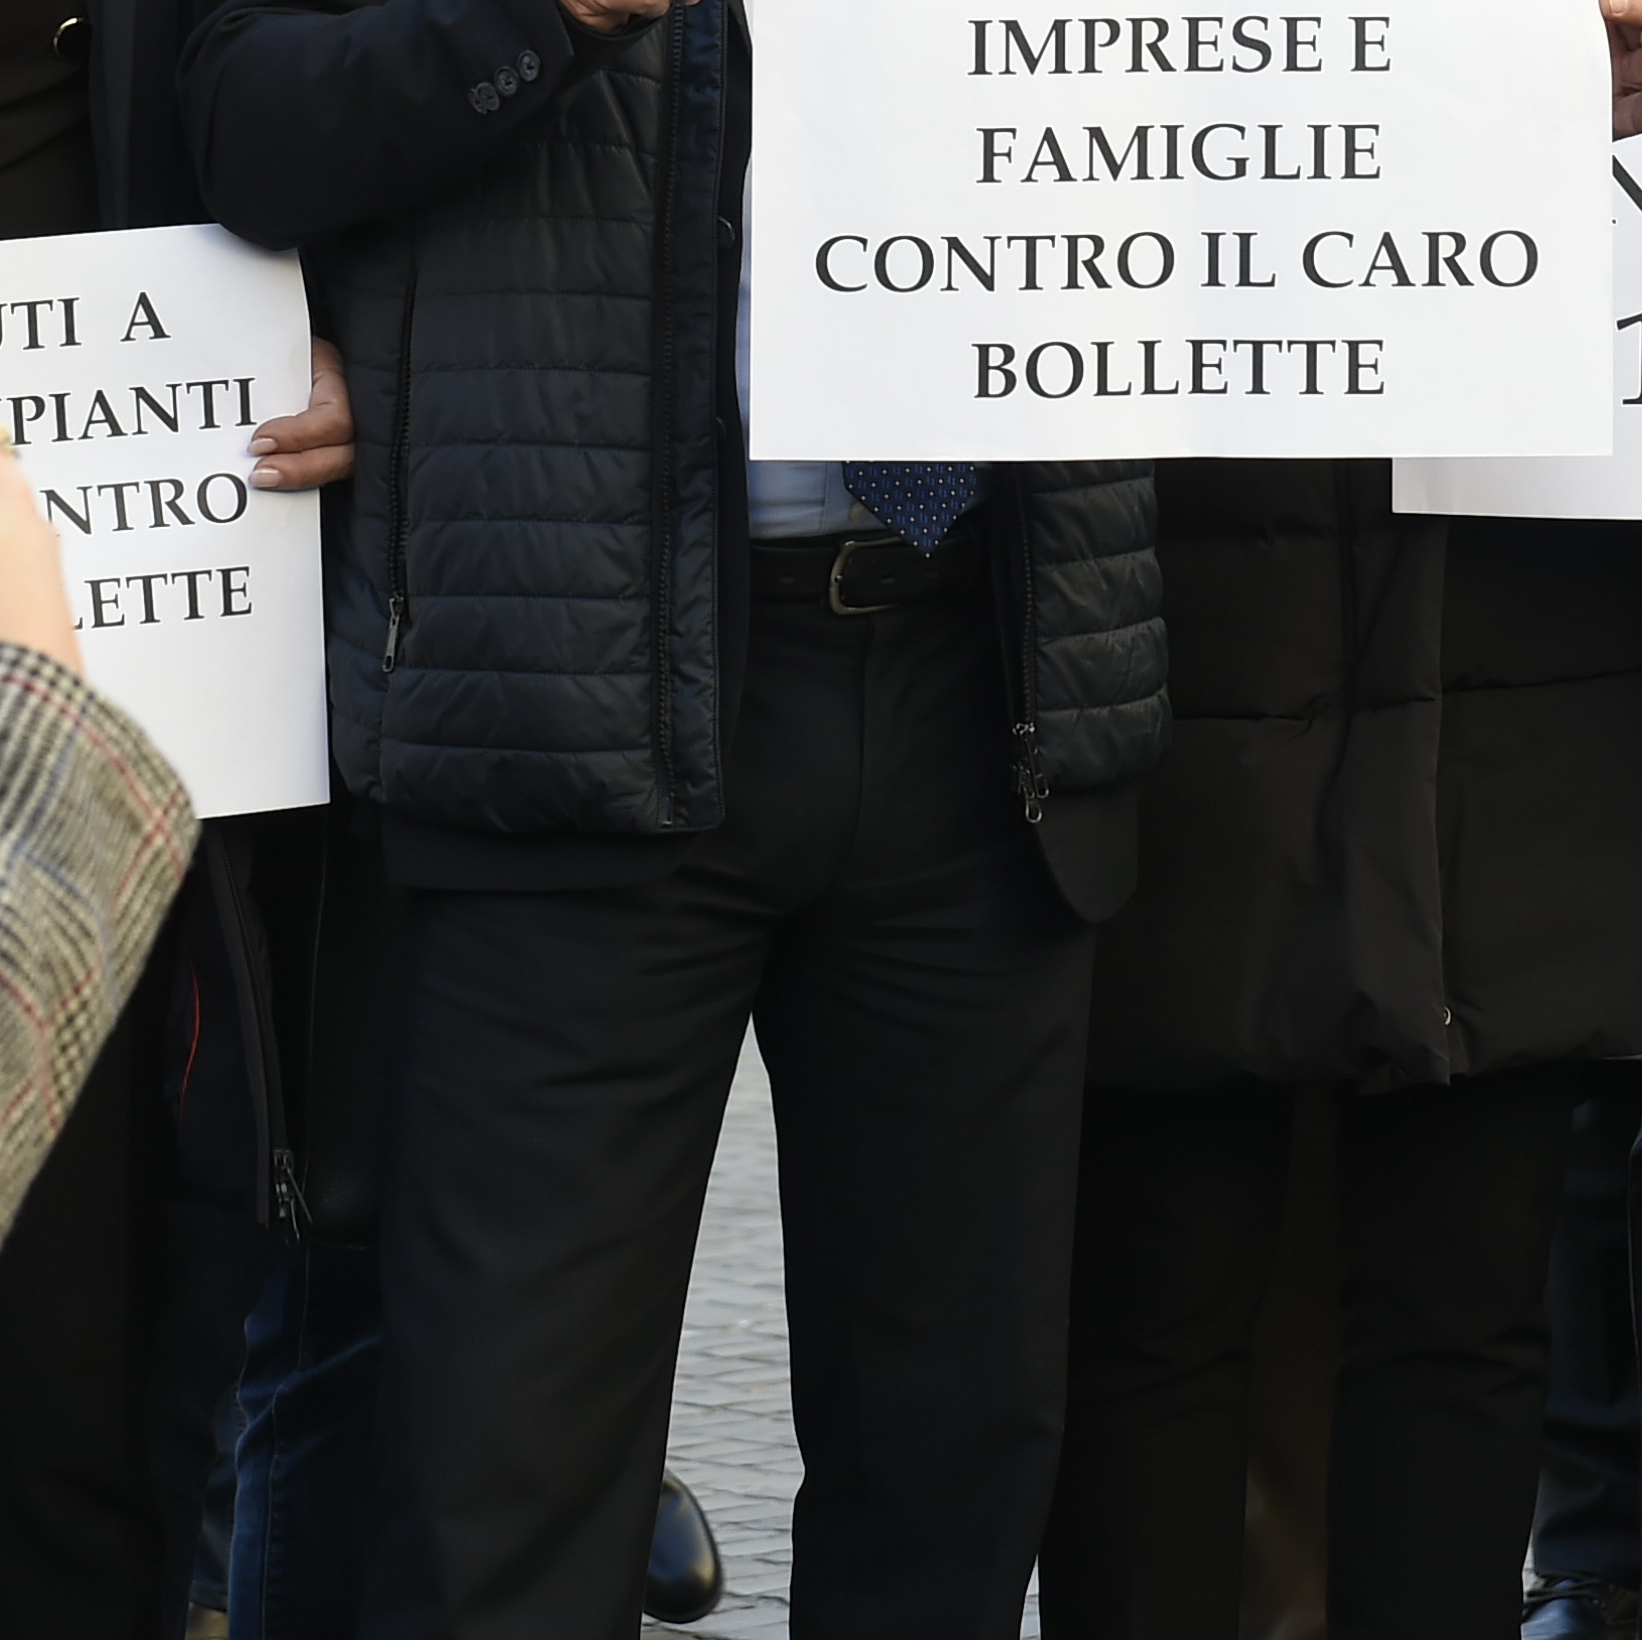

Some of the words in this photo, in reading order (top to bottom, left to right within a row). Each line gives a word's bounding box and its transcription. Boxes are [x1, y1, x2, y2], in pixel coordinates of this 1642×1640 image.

[967, 15, 1323, 76] IMPRESE
[1347, 16, 1391, 72] E
[976, 123, 1381, 184] FAMIGLIE
[815, 231, 1175, 293] CONTRO
[1200, 231, 1276, 288] IL
[1302, 230, 1539, 289] CARO
[120, 291, 172, 343] A
[971, 339, 1385, 399] BOLLETTE
[39, 472, 249, 536] NTRO
